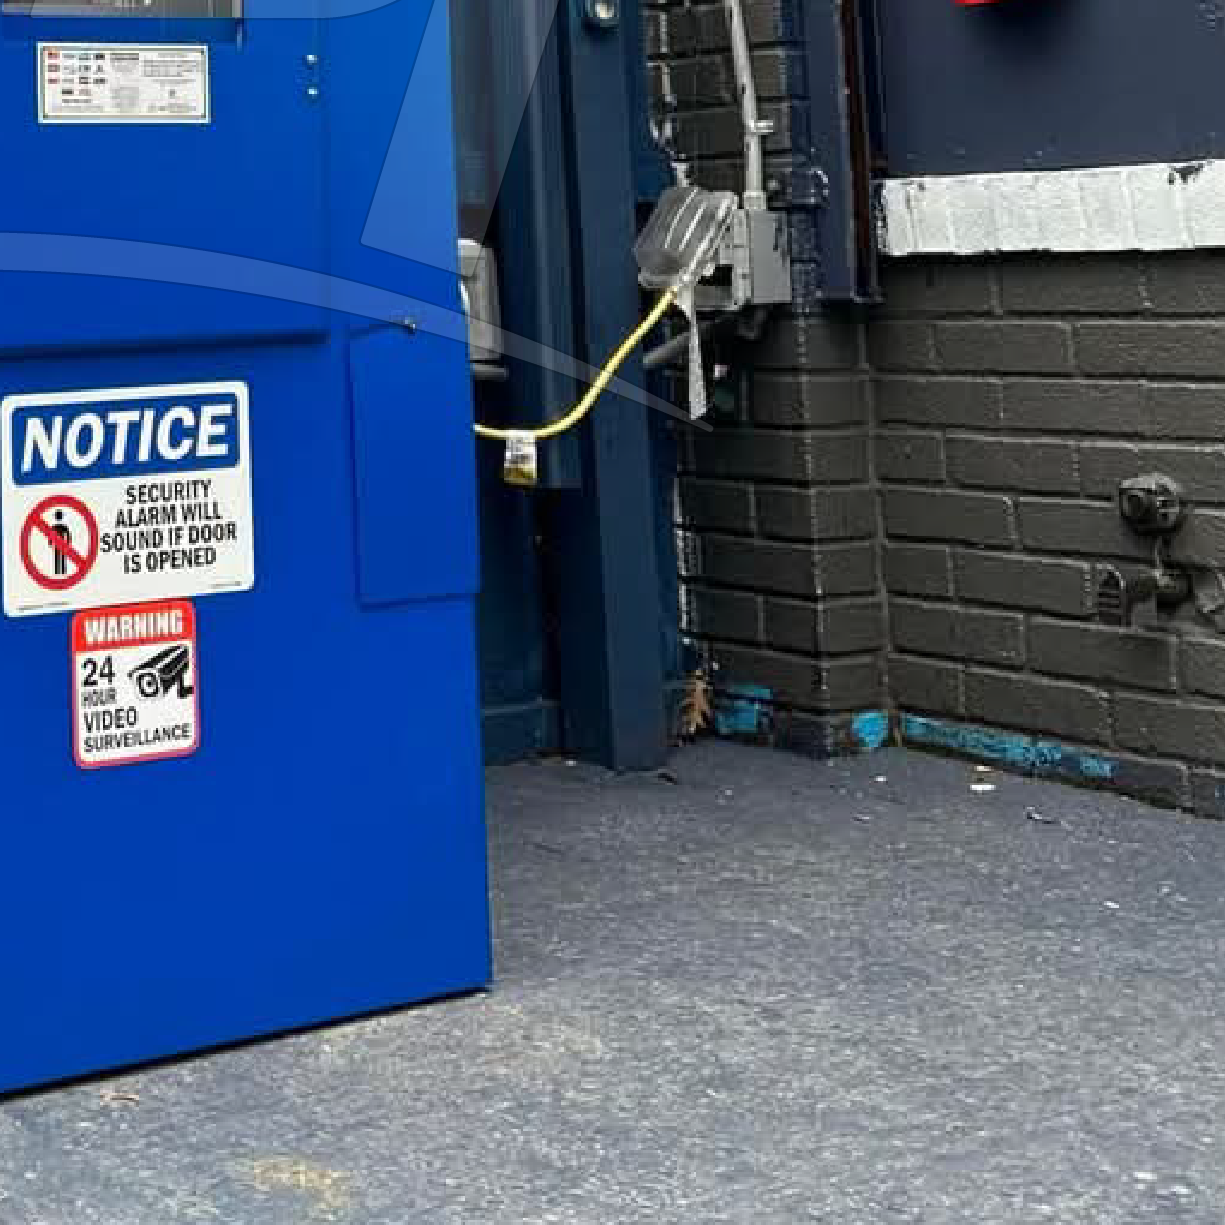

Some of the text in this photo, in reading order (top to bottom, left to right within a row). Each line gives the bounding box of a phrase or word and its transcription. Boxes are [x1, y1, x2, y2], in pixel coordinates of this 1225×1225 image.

[21, 404, 233, 474] NOTICE
[126, 479, 212, 505] SECURITY
[115, 502, 223, 529] ALARM WILL
[100, 521, 237, 552] SOUND IF DOOR
[124, 546, 217, 574] IS OPENED
[85, 609, 183, 642] WARNING
[81, 656, 116, 688] 24
[81, 686, 117, 708] HOUR
[83, 705, 139, 734] VIDEO
[83, 723, 193, 753] SURVEILLANCE
